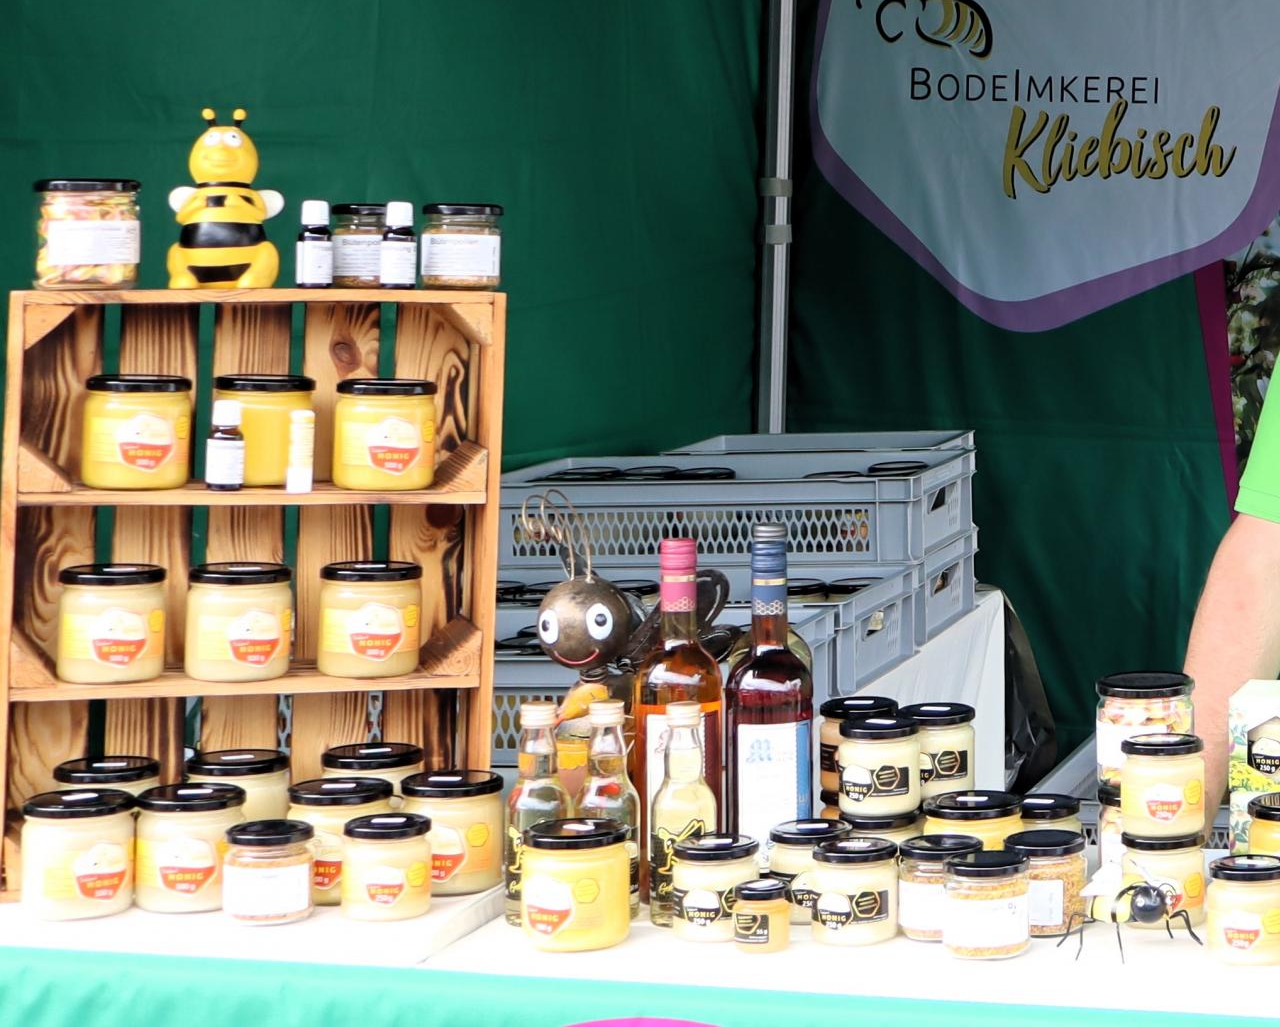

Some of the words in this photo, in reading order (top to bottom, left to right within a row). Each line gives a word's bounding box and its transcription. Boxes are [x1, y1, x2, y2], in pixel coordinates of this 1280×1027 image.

[909, 67, 1160, 105] BODEIMKEREI
[1002, 97, 1237, 200] Kliebisch
[846, 785, 868, 793] HONIG
[821, 914, 847, 922] HONIG
